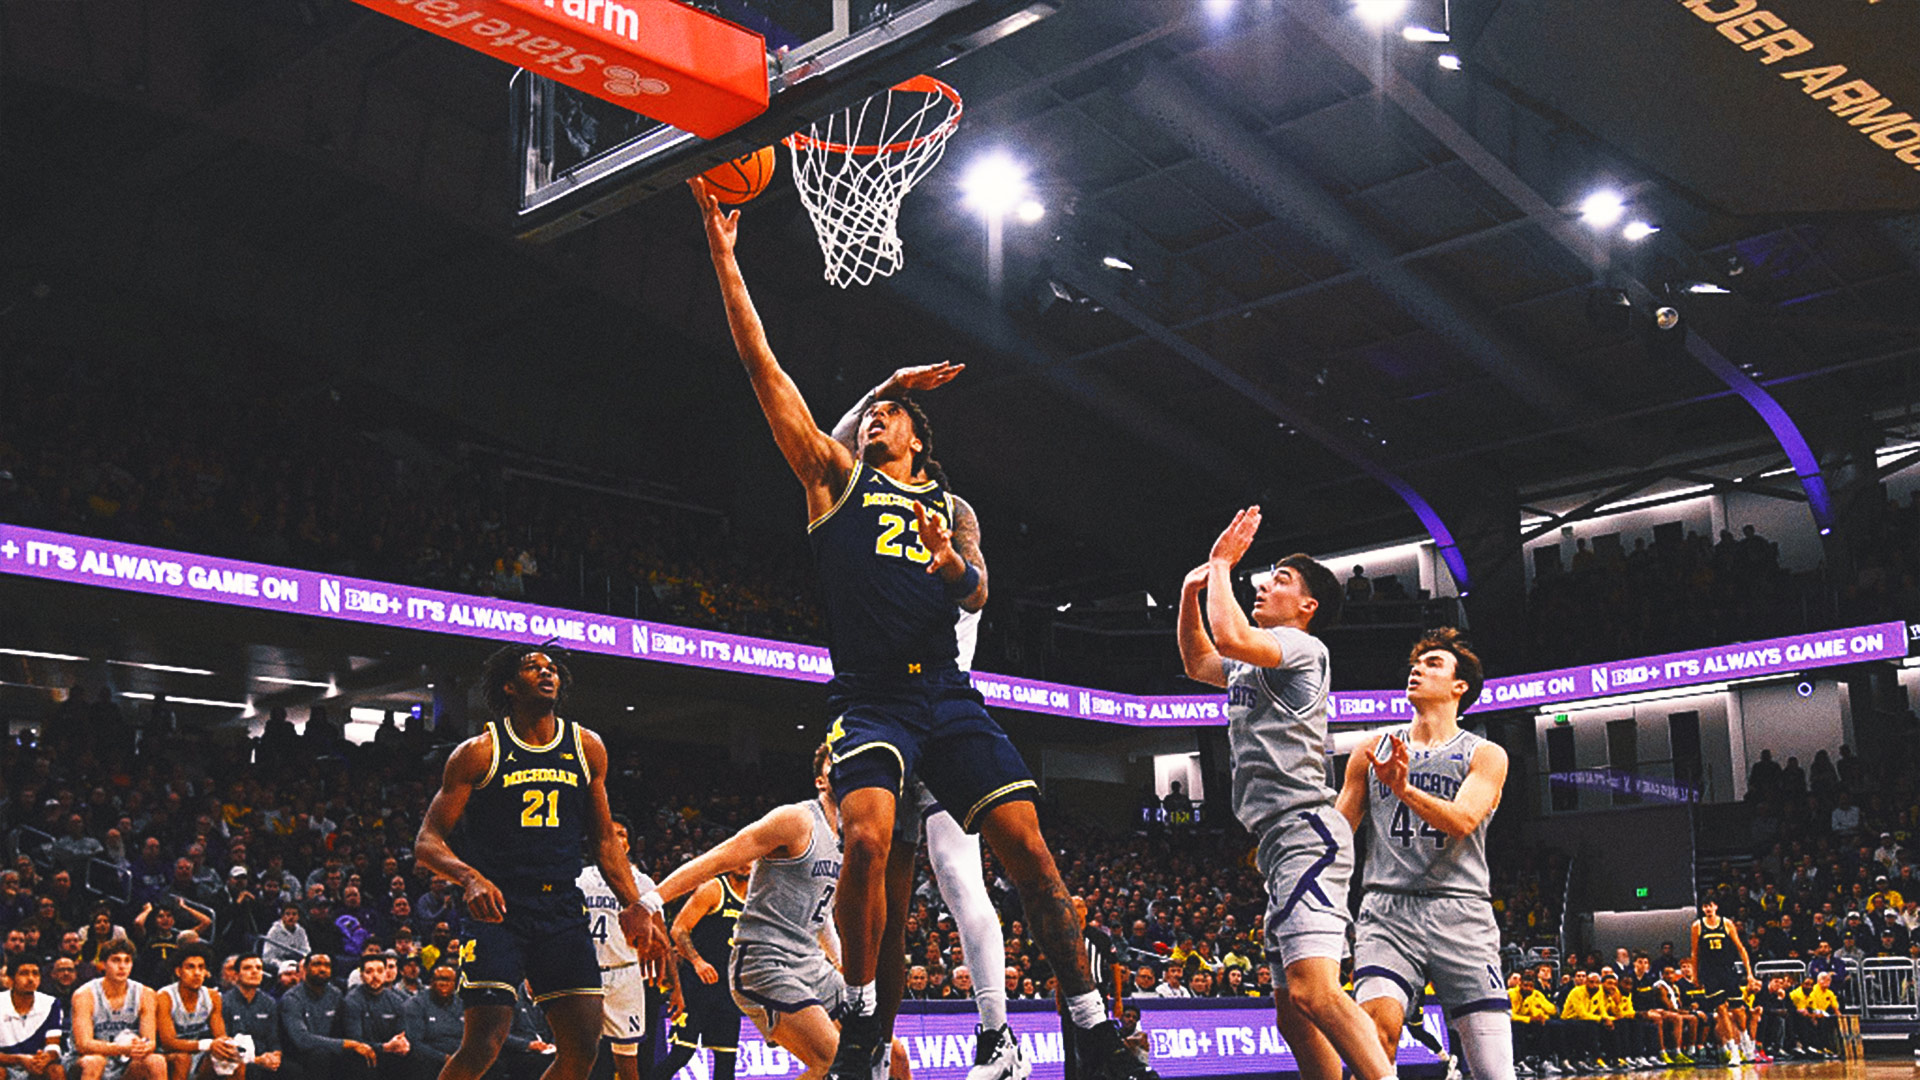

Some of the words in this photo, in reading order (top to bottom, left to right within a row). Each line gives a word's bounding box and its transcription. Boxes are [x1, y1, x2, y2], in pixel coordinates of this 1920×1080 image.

[544, 0, 639, 42] arm
[875, 512, 948, 564] 23
[26, 541, 77, 570] IT'S
[80, 550, 184, 586] ALWAYS
[187, 566, 259, 597] GAME
[262, 577, 298, 602] ON
[320, 579, 340, 613] N
[407, 597, 446, 621] IT'S
[447, 604, 528, 633] ALWAYS
[530, 615, 585, 641] GAME
[587, 624, 616, 646] ON
[632, 624, 649, 654] N
[700, 639, 731, 661] IT'S
[733, 645, 796, 670] ALWAYS
[797, 654, 835, 676] GAM
[1495, 681, 1546, 702] GAME
[1548, 676, 1575, 695] ON
[1664, 659, 1700, 679] IT'S
[1703, 648, 1782, 674] ALWAYS
[1786, 639, 1848, 662] GAME
[1850, 633, 1884, 653] ON
[1012, 686, 1049, 706] GAME
[1049, 691, 1069, 709] ON
[1124, 702, 1147, 719] IT'S
[1149, 702, 1220, 719] ALWAYS
[503, 768, 578, 787] MICHIGAN
[521, 789, 560, 827] 21
[1389, 800, 1449, 850] 44
[1215, 1026, 1256, 1056] IT'S
